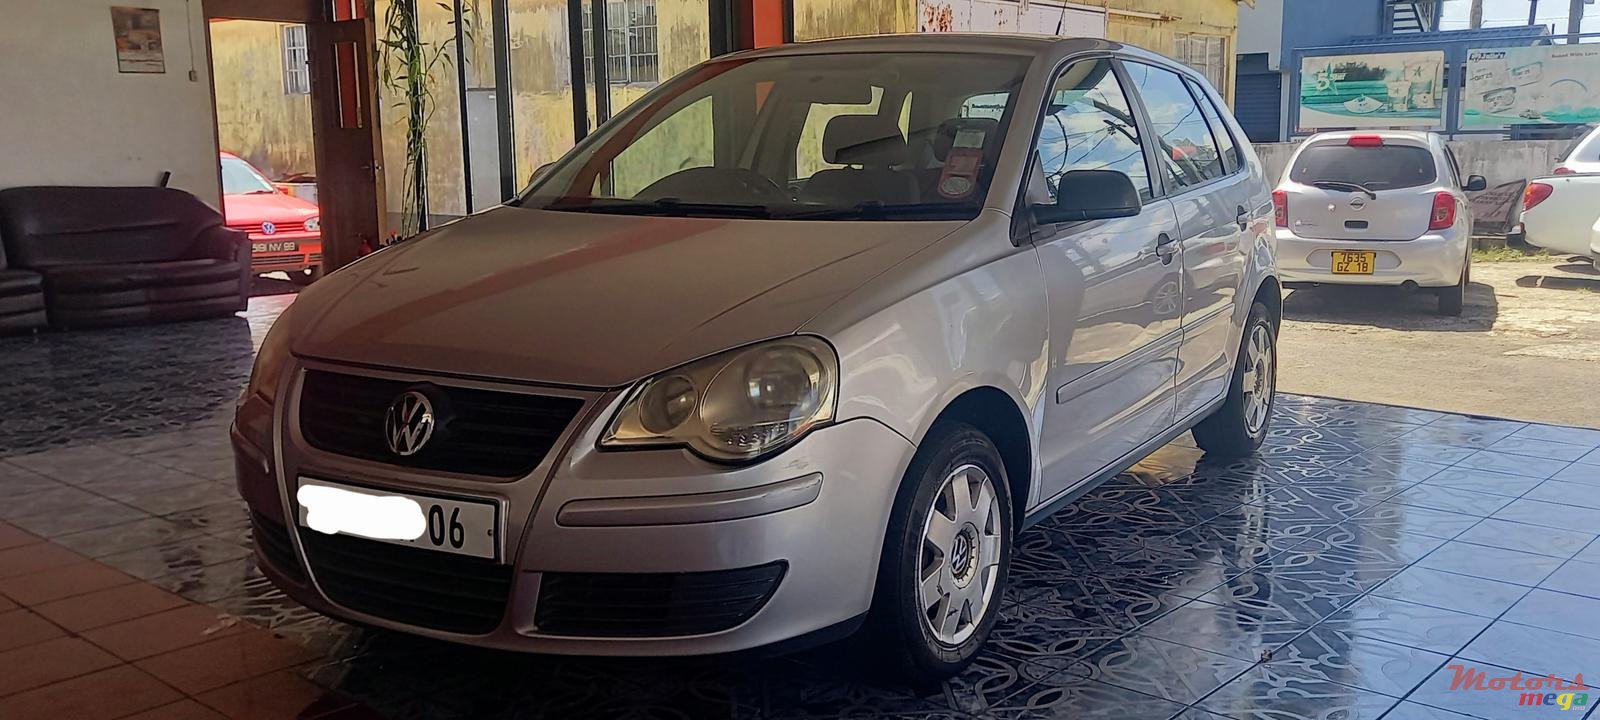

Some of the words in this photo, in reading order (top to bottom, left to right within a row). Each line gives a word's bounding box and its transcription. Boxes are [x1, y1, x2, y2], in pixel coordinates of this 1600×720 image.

[1341, 253, 1366, 262] 7635
[1337, 262, 1349, 271] GZ
[1358, 263, 1368, 272] 18
[429, 504, 465, 549] 06
